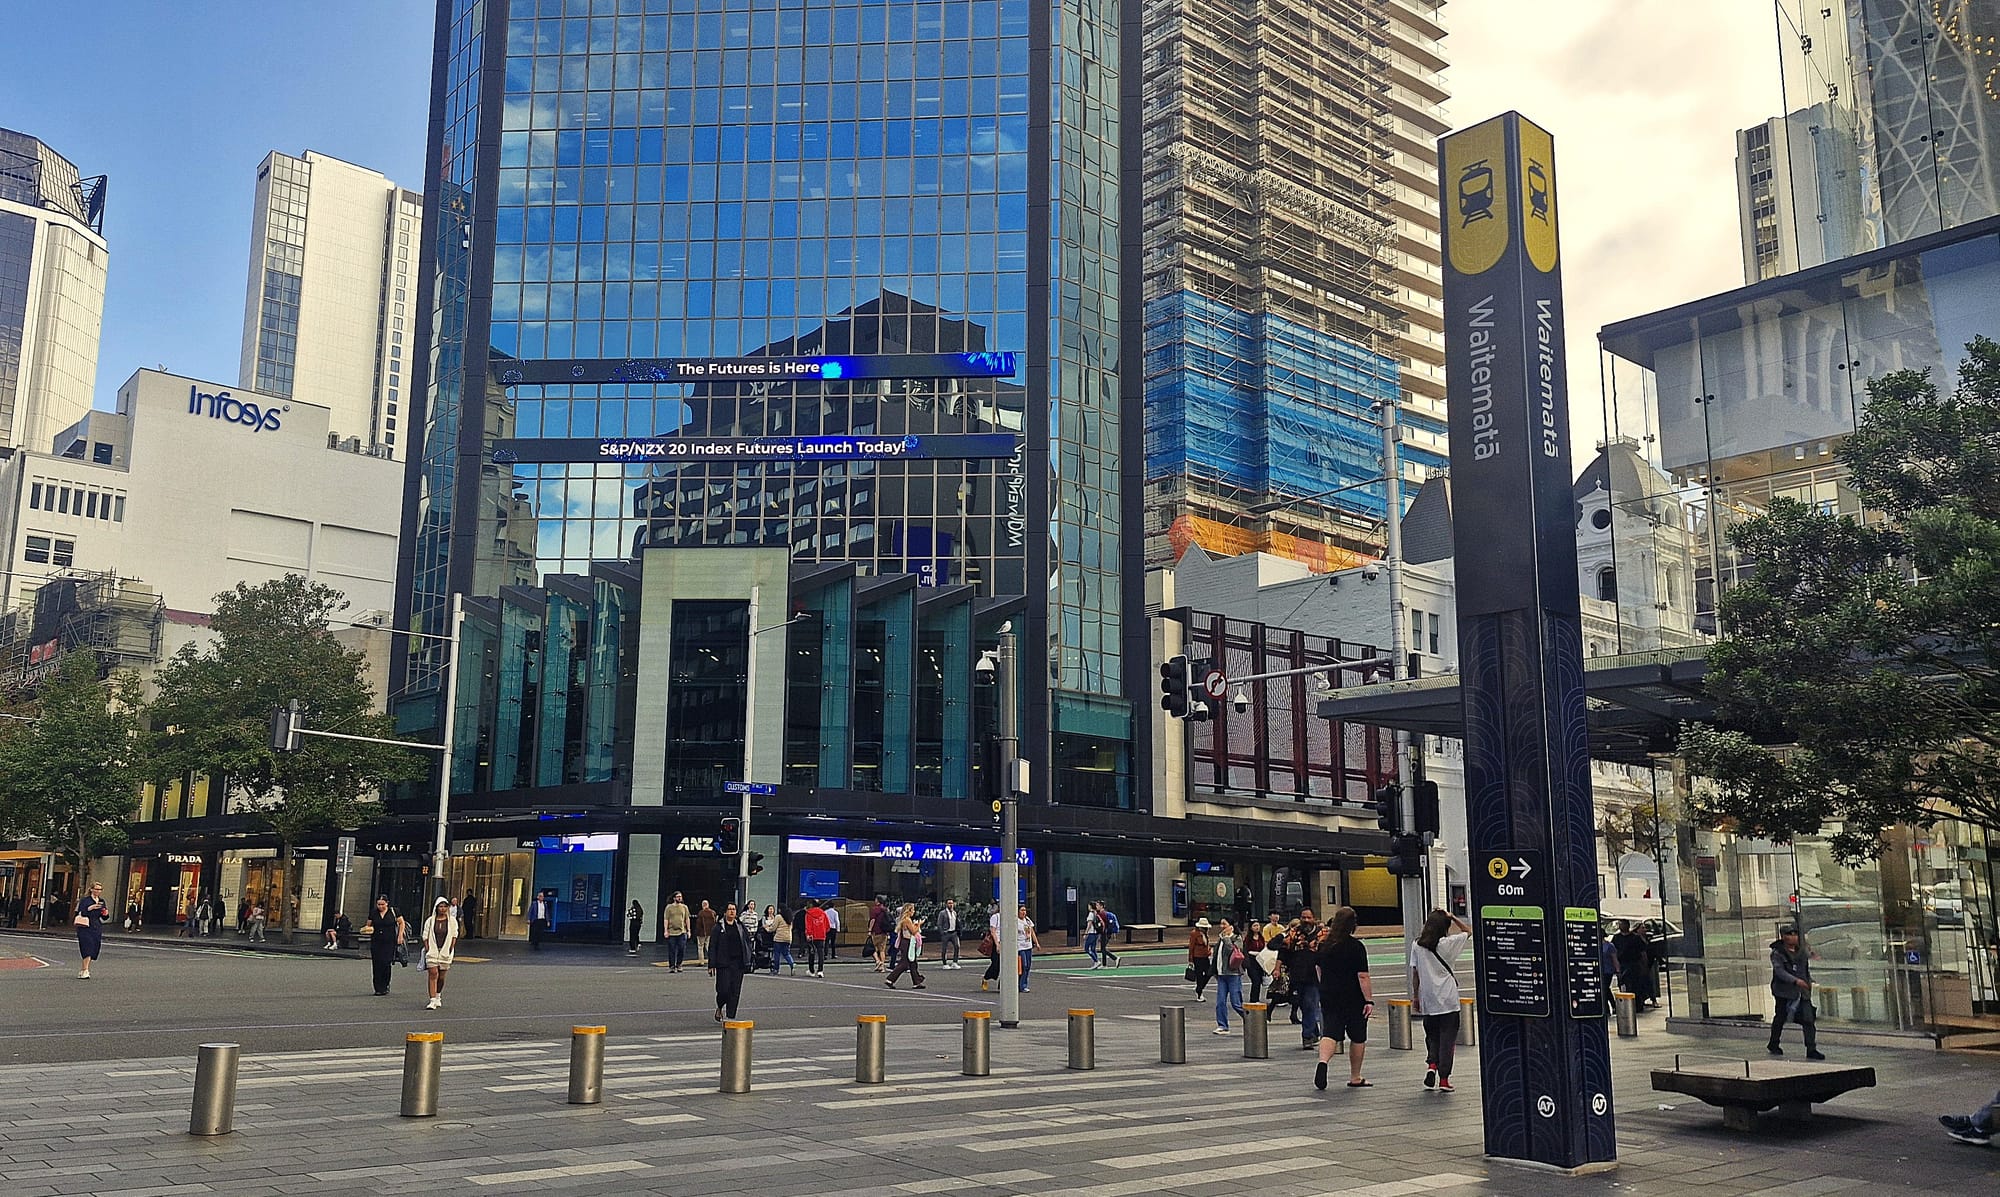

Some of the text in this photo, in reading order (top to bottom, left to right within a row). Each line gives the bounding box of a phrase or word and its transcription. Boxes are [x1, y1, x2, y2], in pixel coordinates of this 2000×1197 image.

[677, 361, 820, 375] The Futures is Here
[1467, 294, 1500, 461] Waitematā
[1536, 299, 1559, 458] Waitematā
[189, 385, 281, 433] Infosys
[599, 441, 906, 456] S&P/NZX 20 Index Futures Launch Today!
[727, 783, 750, 792] CUSTOMS
[376, 843, 412, 852] GRAFF
[464, 843, 490, 853] GRAFF
[677, 837, 714, 851] ANZ
[168, 855, 202, 864] PRADA
[881, 846, 982, 862] ANZ ANZ ANZ
[1498, 884, 1524, 896] 60m
